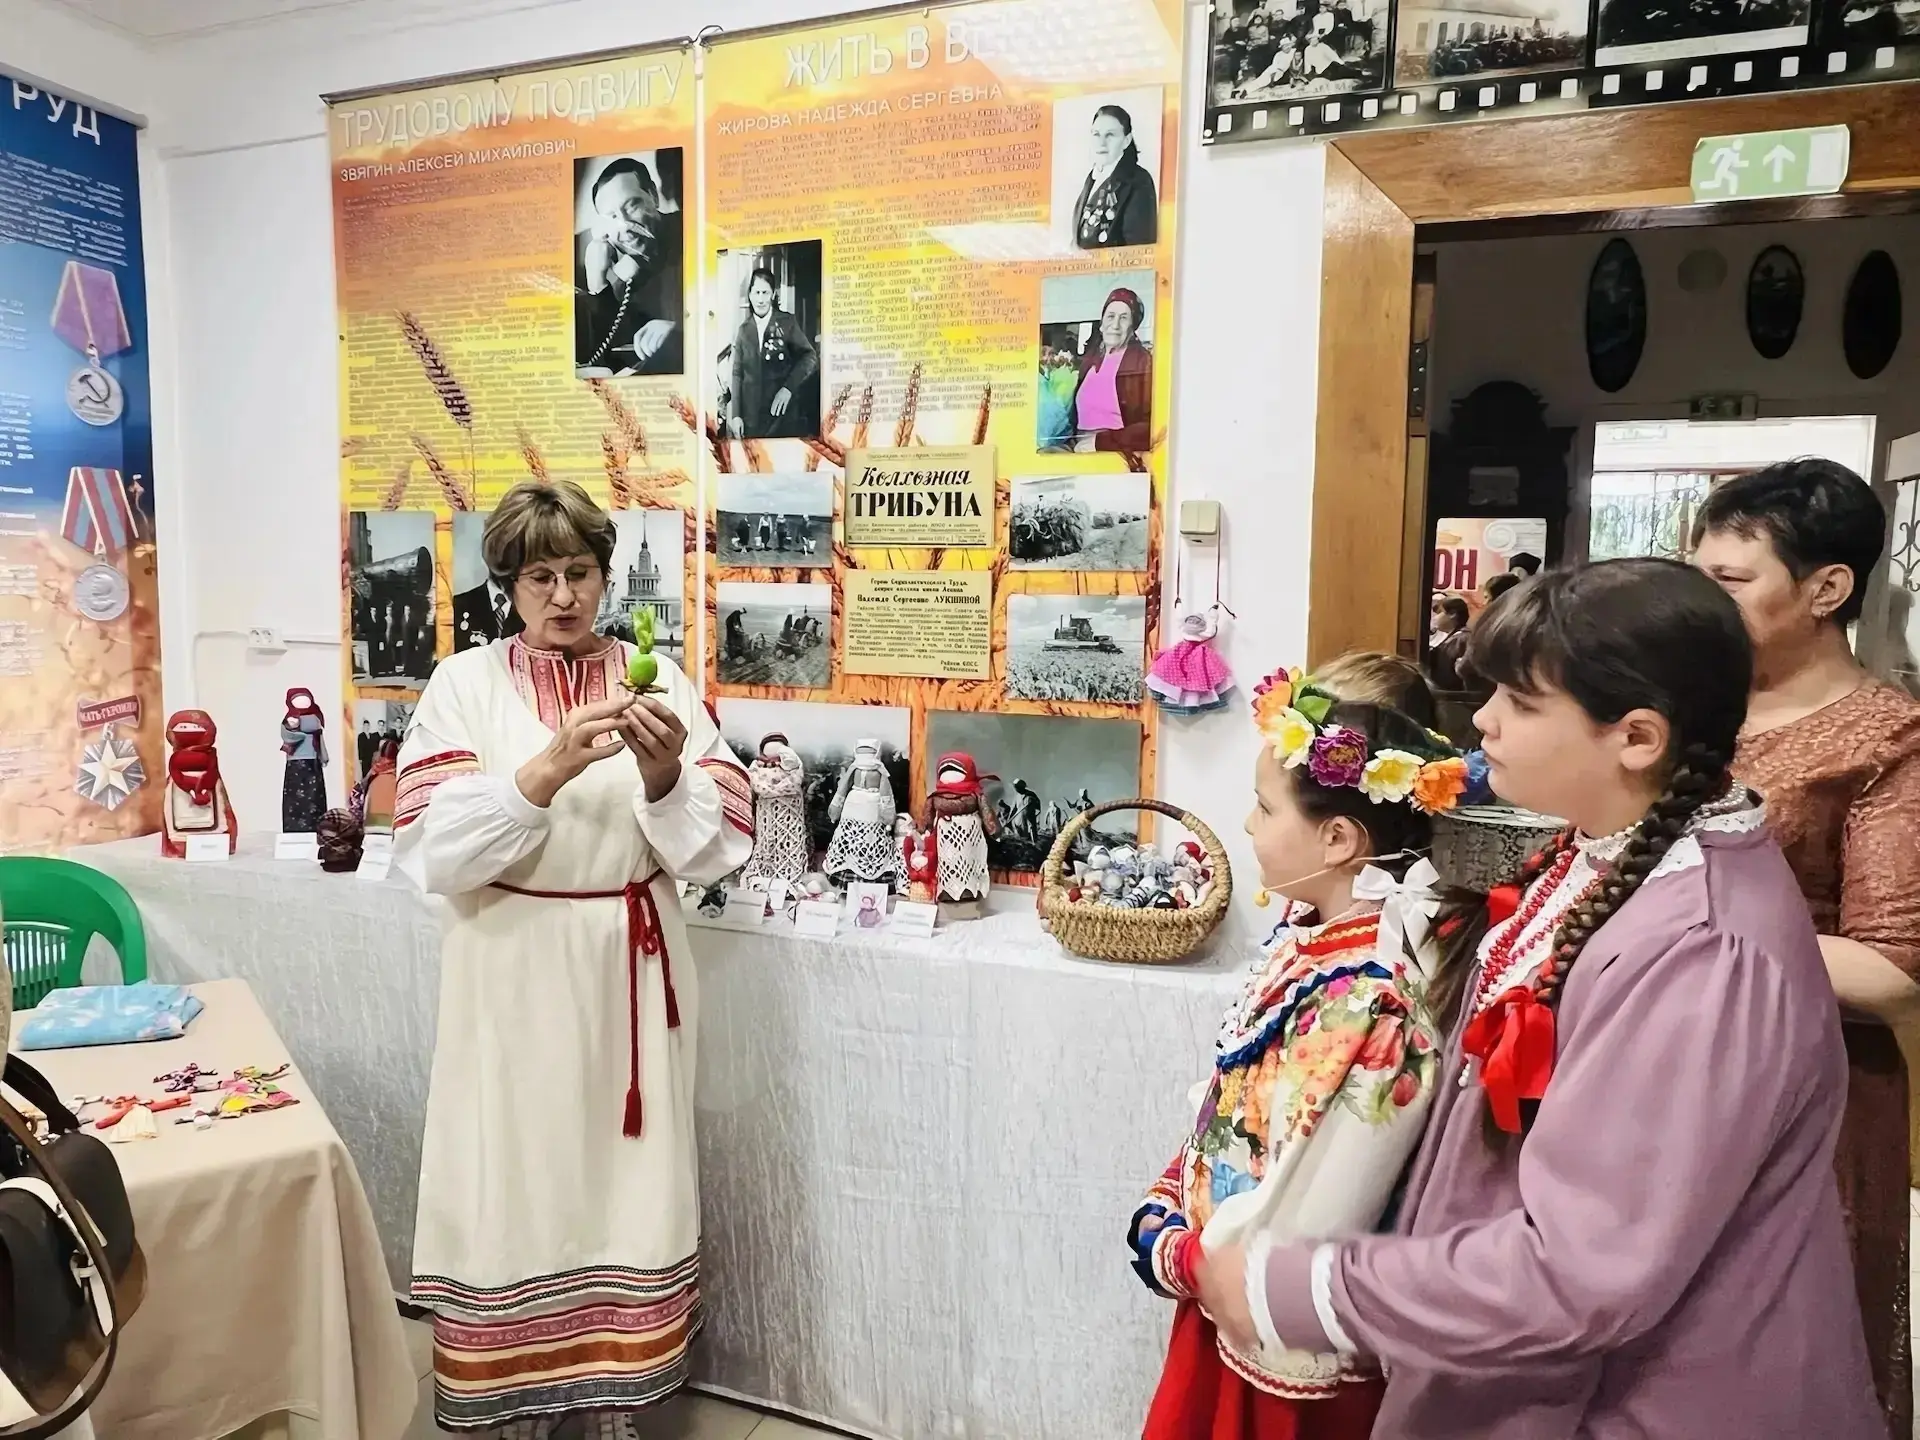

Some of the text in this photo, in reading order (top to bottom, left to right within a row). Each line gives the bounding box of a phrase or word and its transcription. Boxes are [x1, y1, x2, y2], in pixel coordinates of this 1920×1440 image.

[784, 32, 893, 88] ЖИТЬ
[907, 25, 931, 70] В
[338, 60, 684, 150] ТРУДОВОМУ ПОДВИГУ
[717, 83, 1003, 136] ЖИРОВА НАДЕЖДА СЕРГЕВНА
[340, 138, 577, 183] ЗВЯГИН АЛЕКСЕЙ МИХАЙЛОВИЧ
[852, 466, 972, 487] Колхозная
[850, 491, 982, 517] ТРИБУНА
